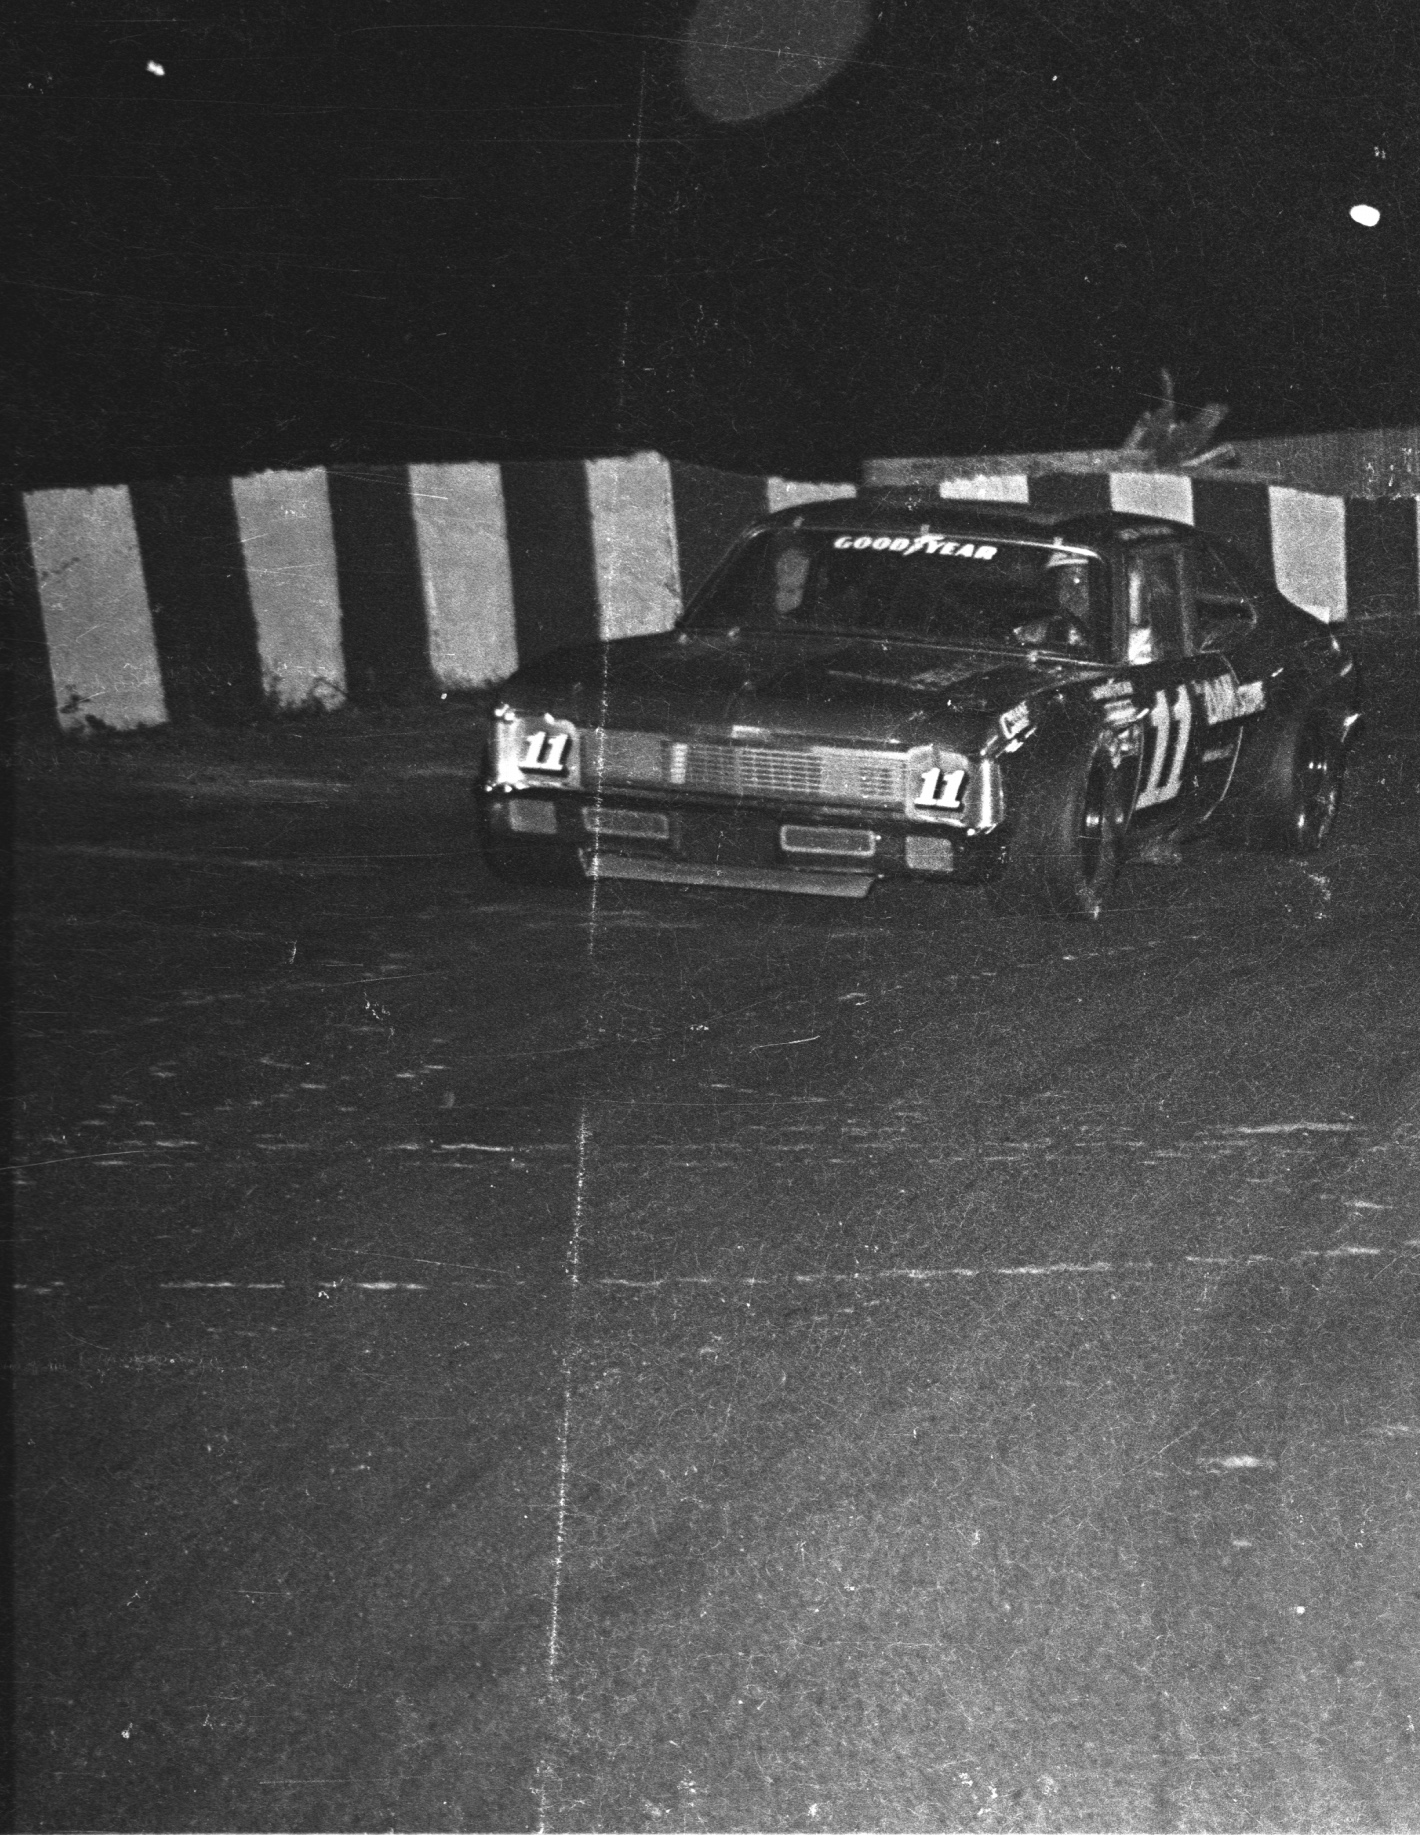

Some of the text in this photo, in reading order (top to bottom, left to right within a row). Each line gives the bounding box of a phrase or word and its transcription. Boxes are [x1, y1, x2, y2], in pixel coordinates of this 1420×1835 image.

[834, 534, 997, 560] GOODYEAR
[519, 731, 570, 775] 11
[1135, 684, 1192, 810] 11
[914, 768, 967, 811] 11
